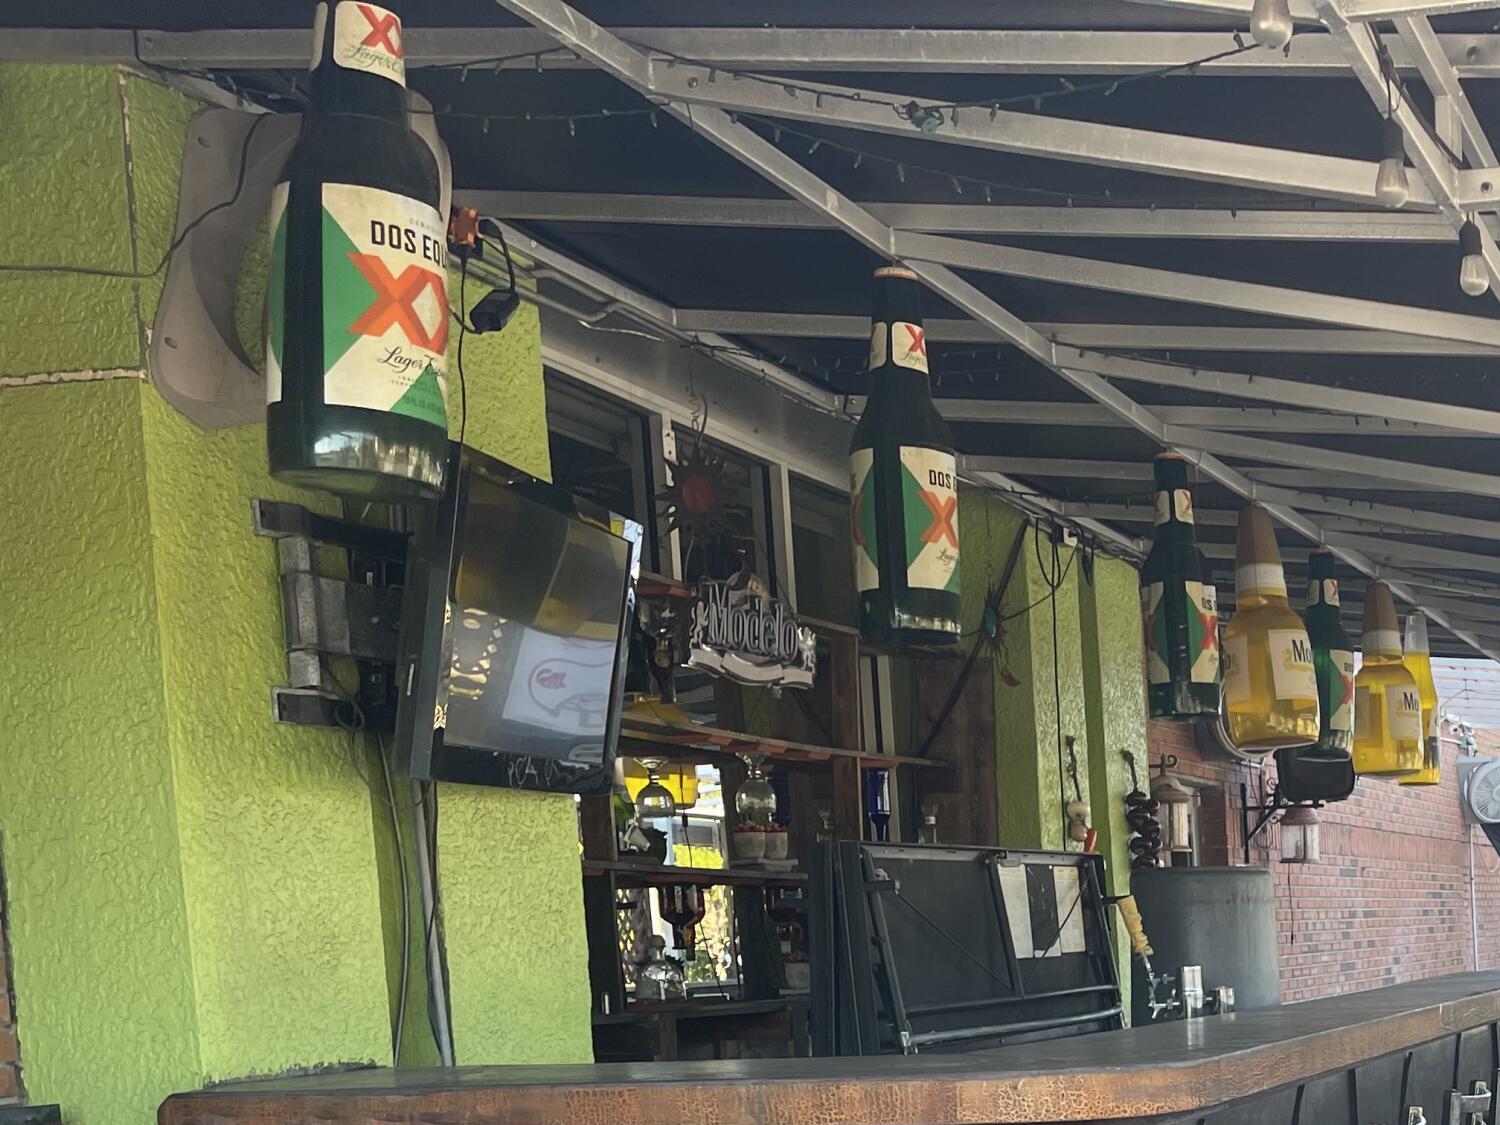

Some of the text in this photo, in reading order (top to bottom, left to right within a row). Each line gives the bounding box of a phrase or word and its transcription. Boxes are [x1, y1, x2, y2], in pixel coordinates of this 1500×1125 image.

[371, 219, 416, 254] DOS
[377, 345, 424, 374] Lager
[928, 469, 952, 490] DOS
[707, 584, 798, 666] Modelo
[1291, 639, 1312, 664] Mo
